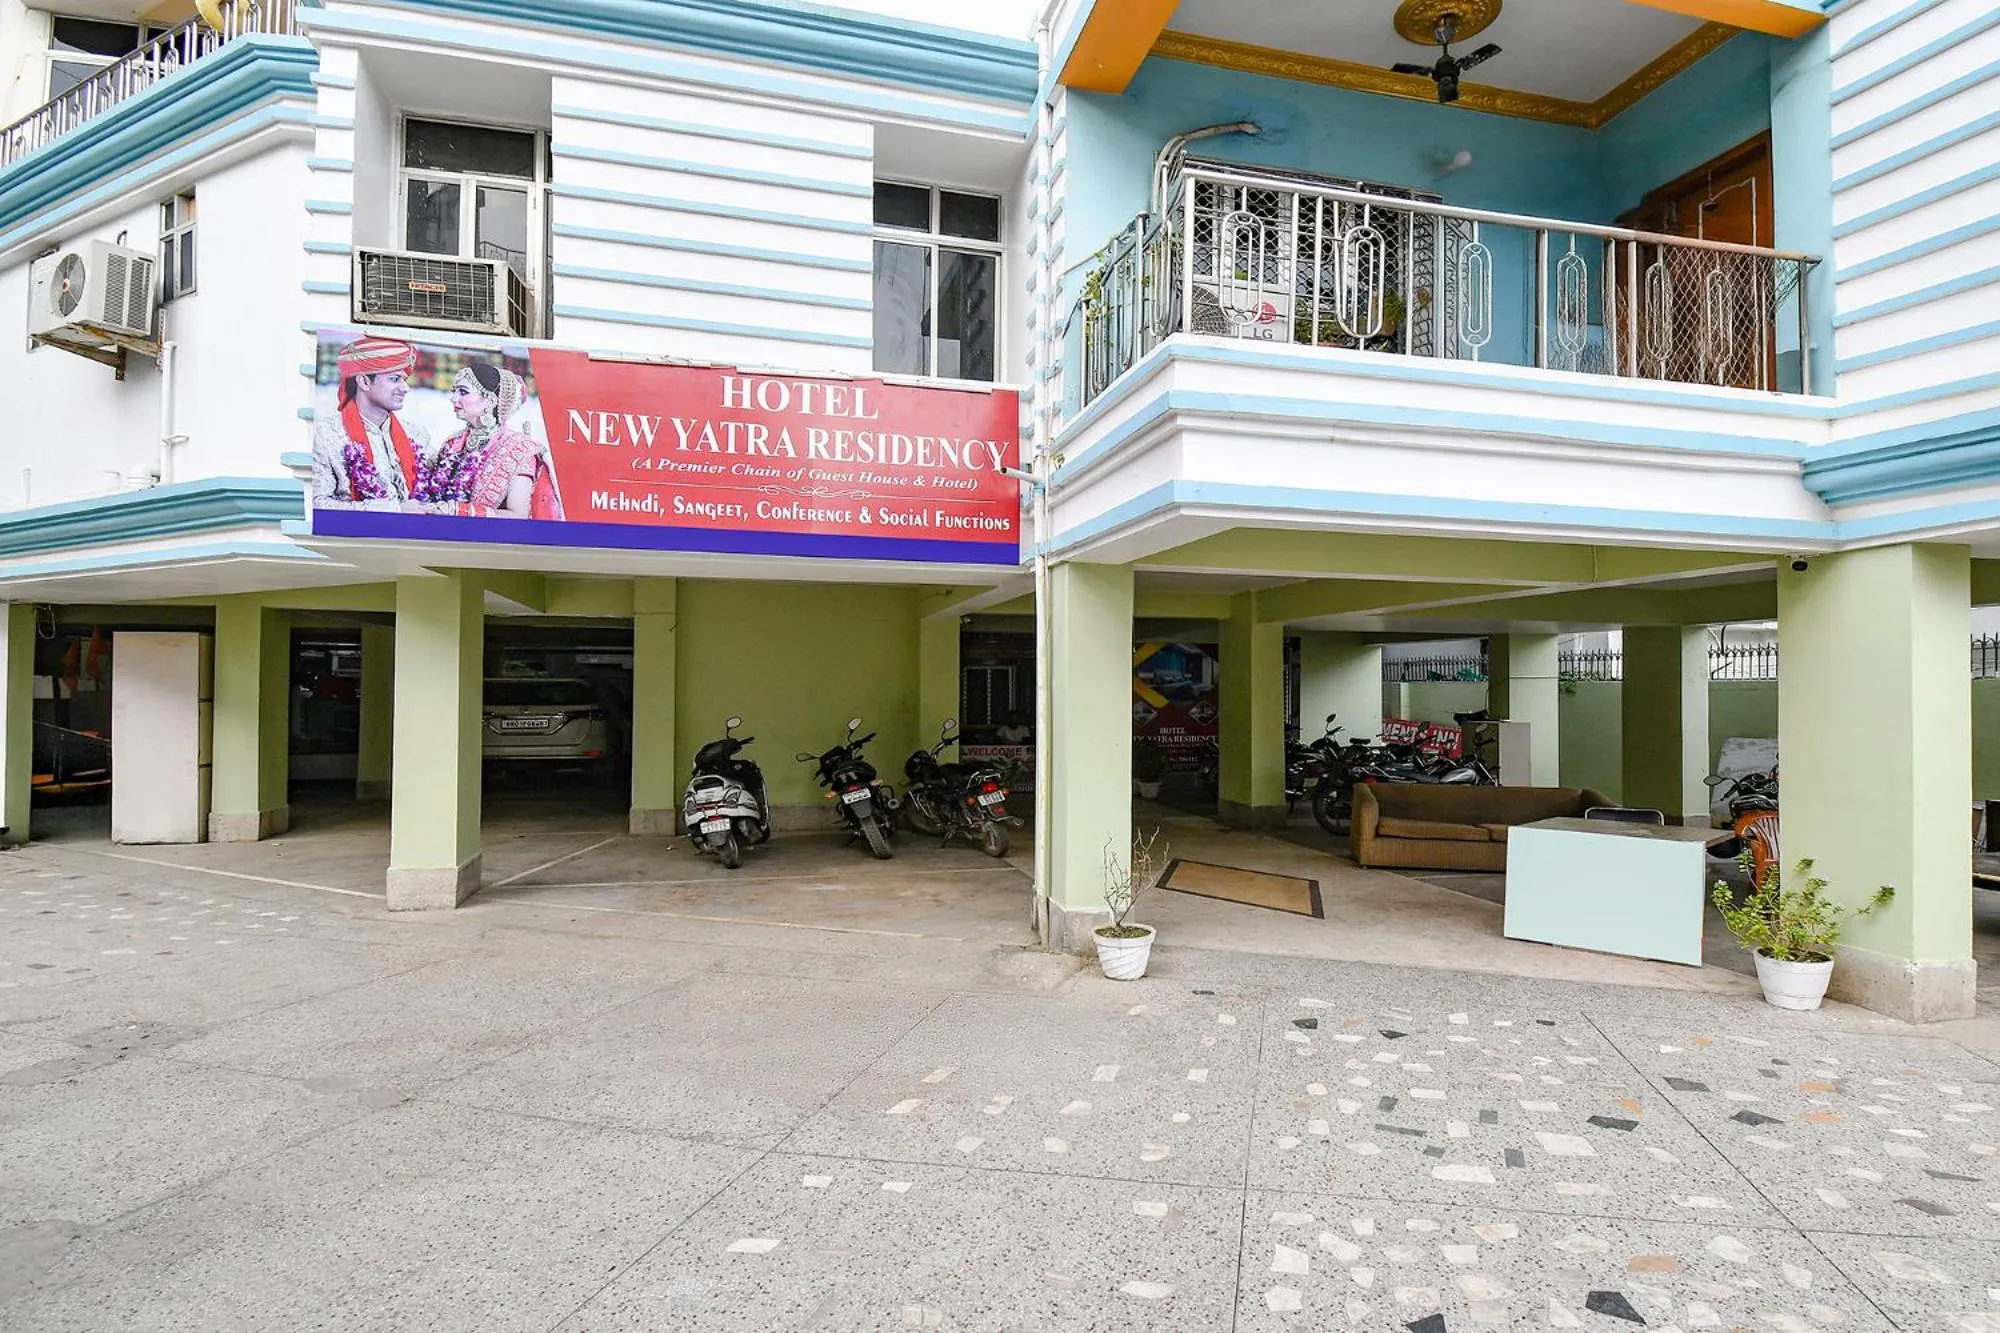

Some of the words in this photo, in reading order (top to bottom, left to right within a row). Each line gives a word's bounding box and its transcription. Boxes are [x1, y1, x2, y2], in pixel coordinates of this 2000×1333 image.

[411, 283, 446, 292] HITACHI
[1253, 327, 1273, 340] LG
[720, 375, 879, 421] HOTEL
[565, 408, 661, 449] NEW
[669, 416, 799, 459] YATRA
[805, 426, 1010, 472] RESIDENCY
[631, 456, 652, 470] (A
[656, 458, 726, 475] Premier
[731, 463, 781, 478] Chain
[786, 467, 804, 482] of
[808, 468, 853, 482] Guest
[858, 471, 911, 486] House
[912, 475, 926, 487] &
[932, 476, 979, 491] Hotel)
[858, 506, 873, 524] &
[1159, 727, 1187, 735] HOTEL
[967, 747, 1022, 756] WELCOME
